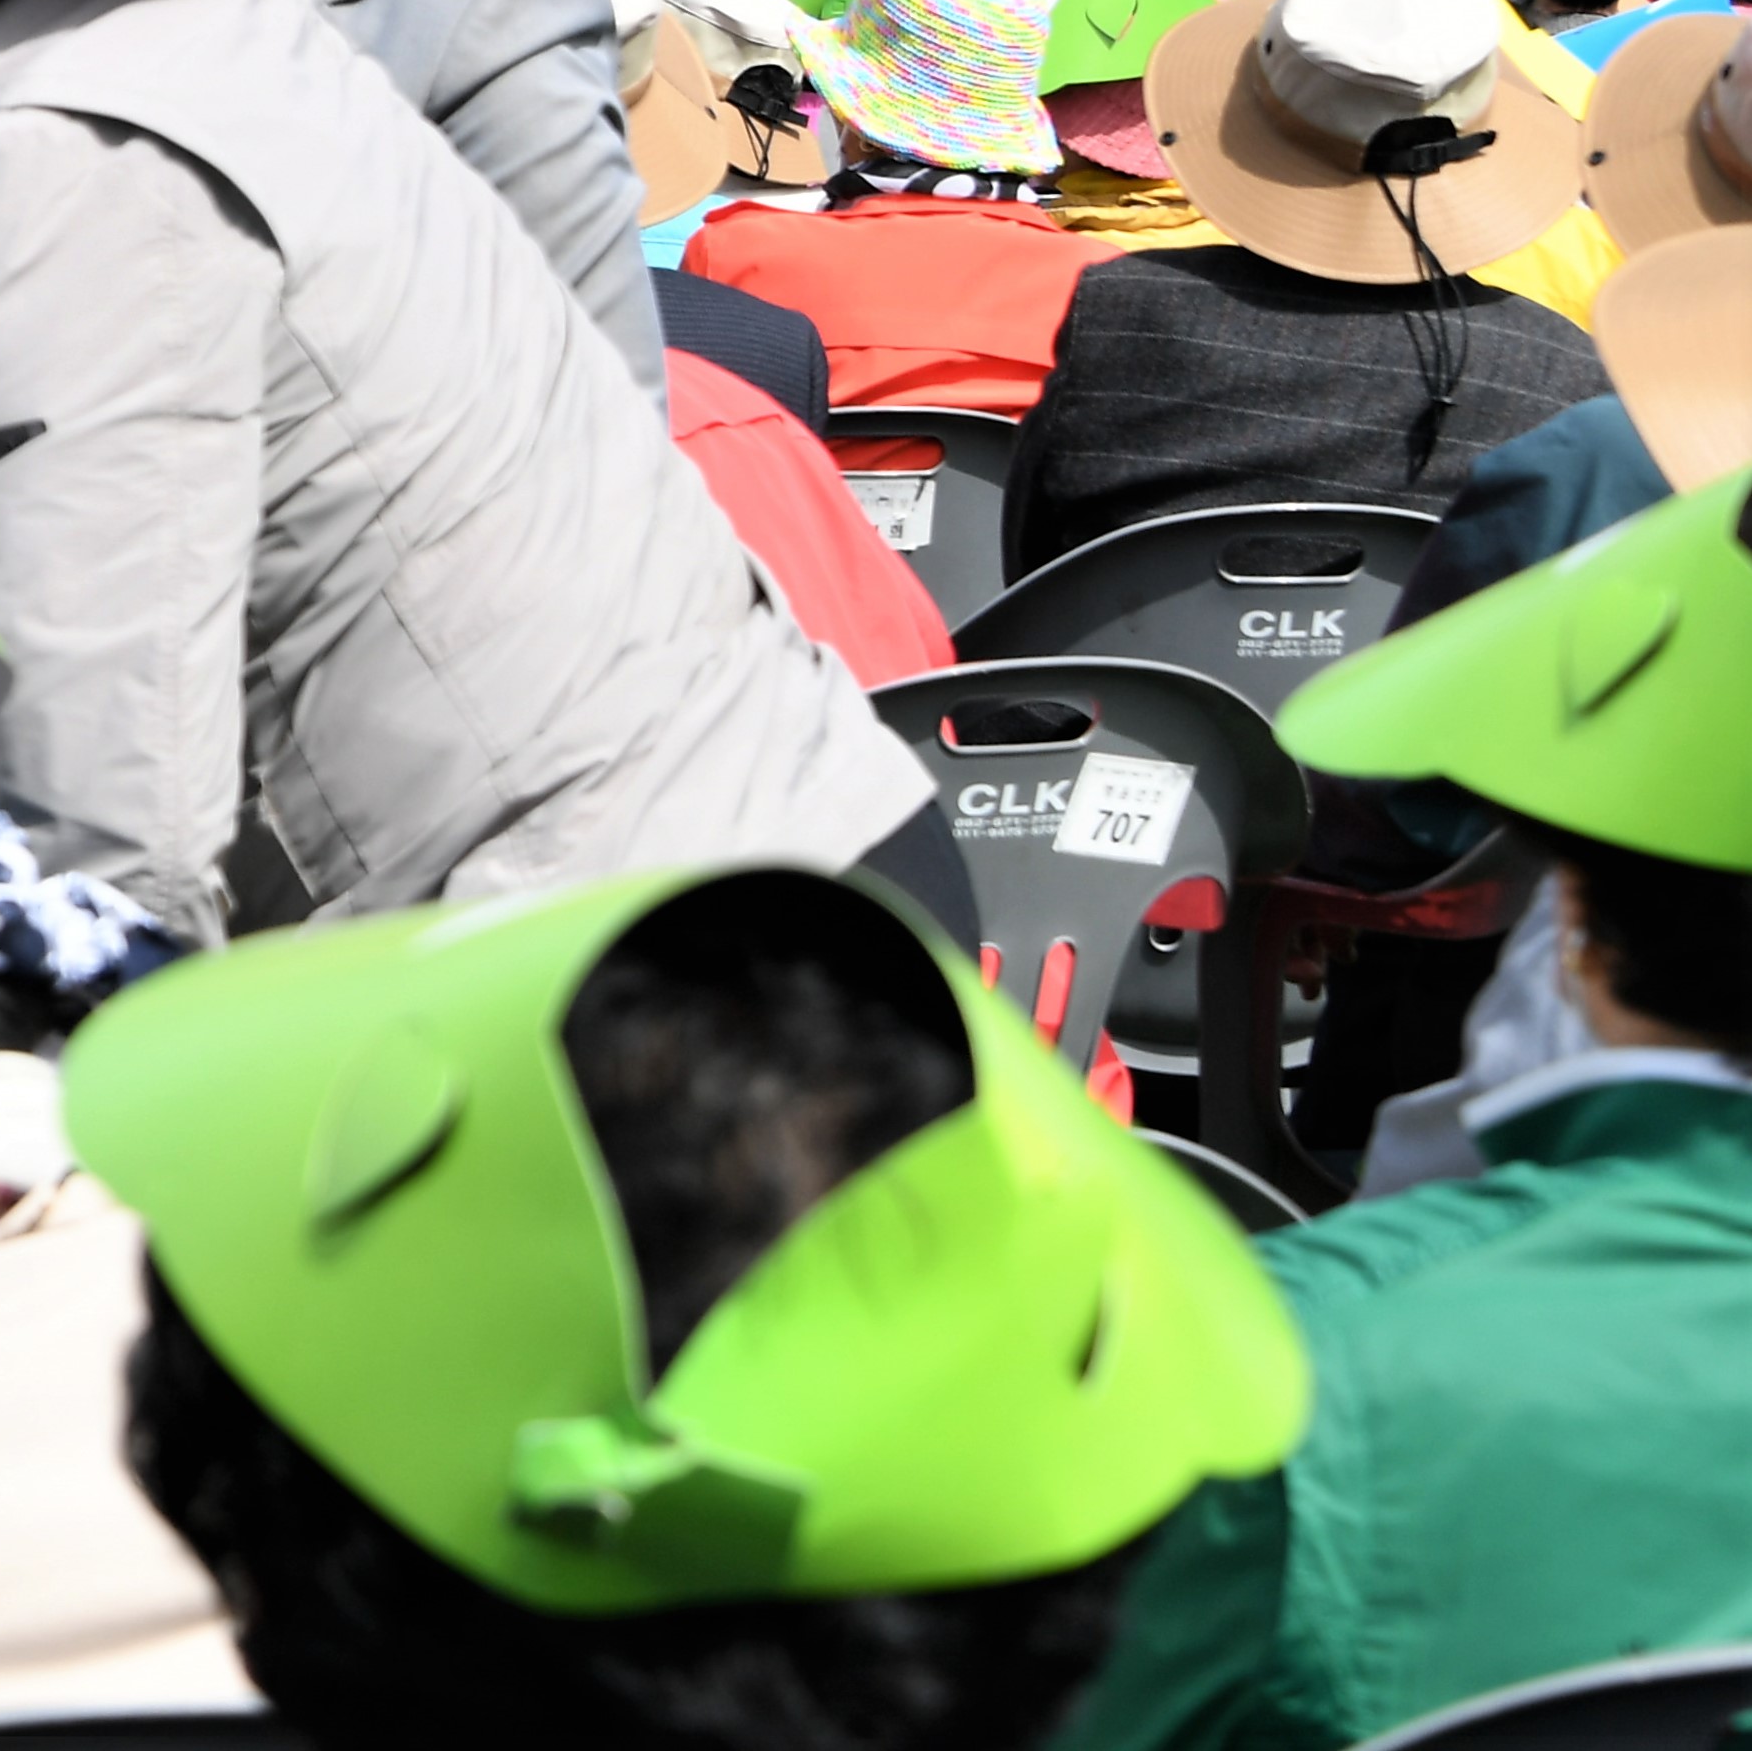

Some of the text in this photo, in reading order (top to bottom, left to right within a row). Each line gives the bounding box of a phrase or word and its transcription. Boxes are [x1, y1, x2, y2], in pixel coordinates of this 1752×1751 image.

[1239, 609, 1346, 638] CLK
[957, 779, 1073, 816] CLK
[1091, 809, 1152, 845] 707
